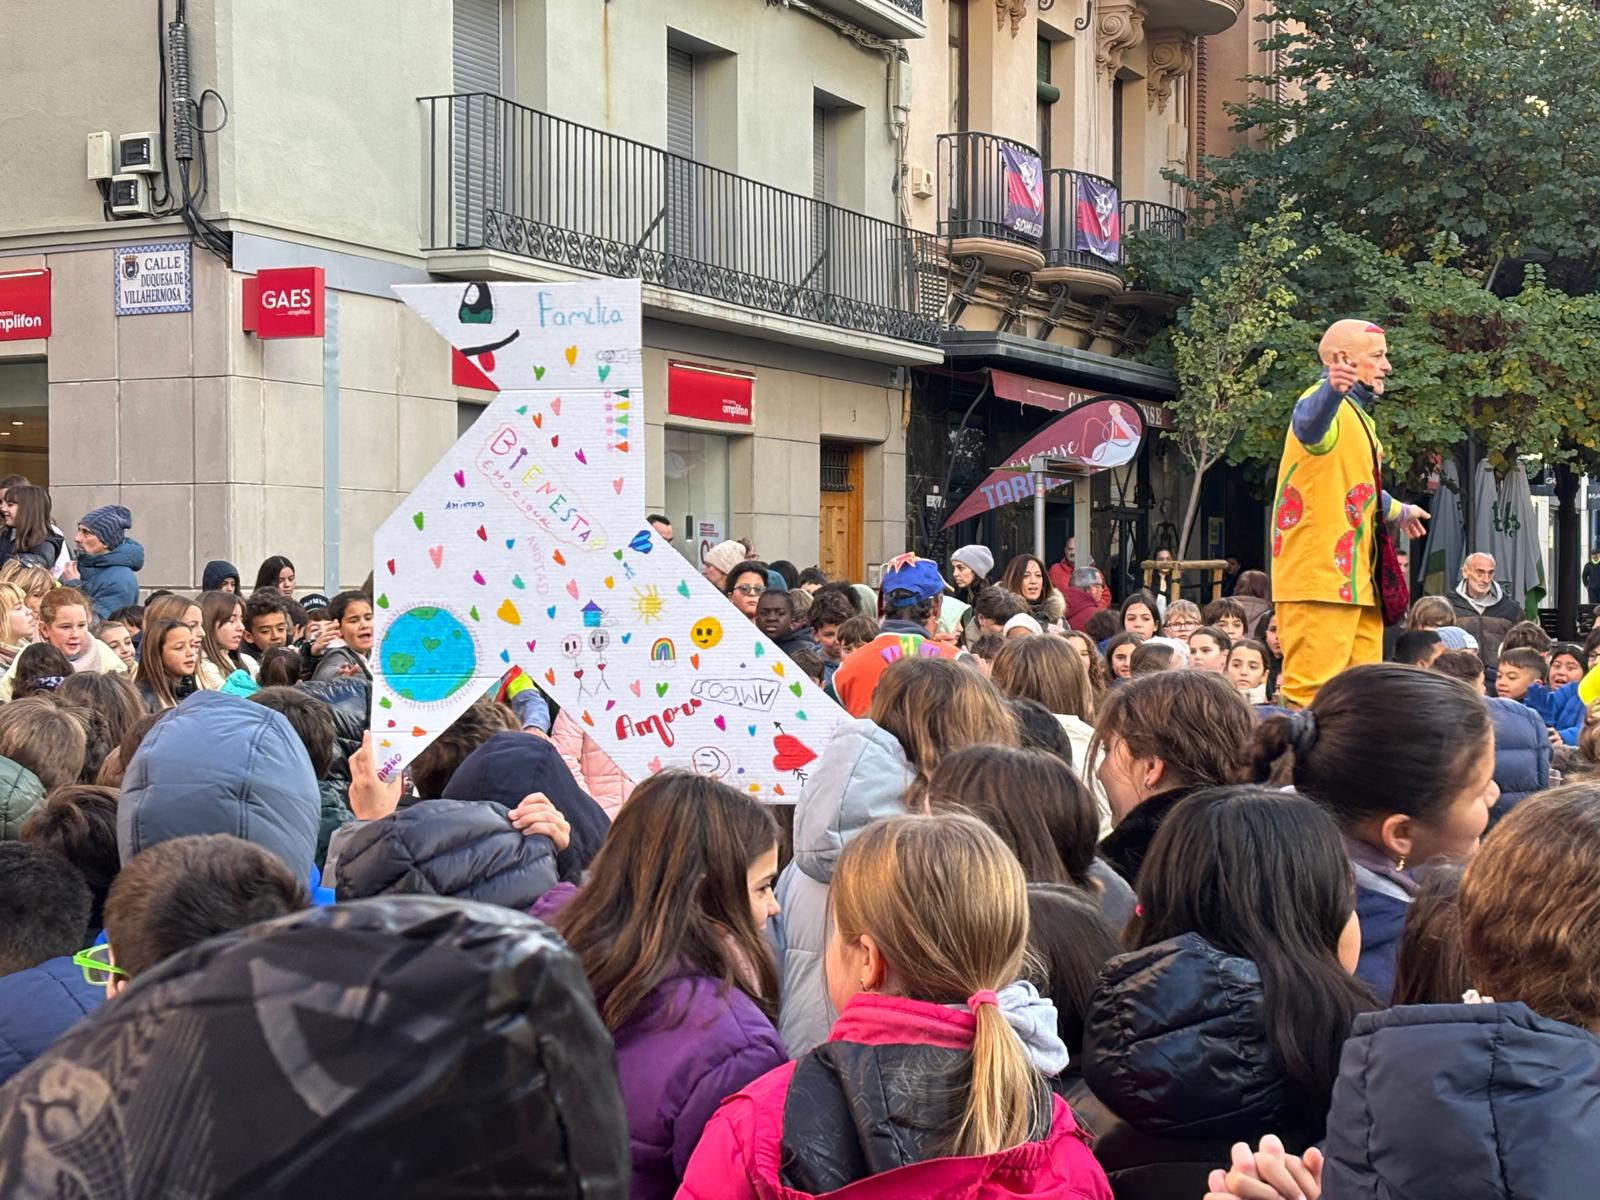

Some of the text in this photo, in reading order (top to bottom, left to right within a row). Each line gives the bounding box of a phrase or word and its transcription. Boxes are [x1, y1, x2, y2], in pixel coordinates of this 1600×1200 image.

[144, 256, 181, 271] CALLE
[141, 271, 184, 288] DUQUESA DE
[124, 287, 182, 305] VILLAHERMOSA
[261, 288, 312, 310] GAES
[538, 291, 624, 328] Familia
[722, 404, 749, 417] amplifon
[696, 680, 775, 706] AMIGOS
[615, 698, 702, 748] Amor
